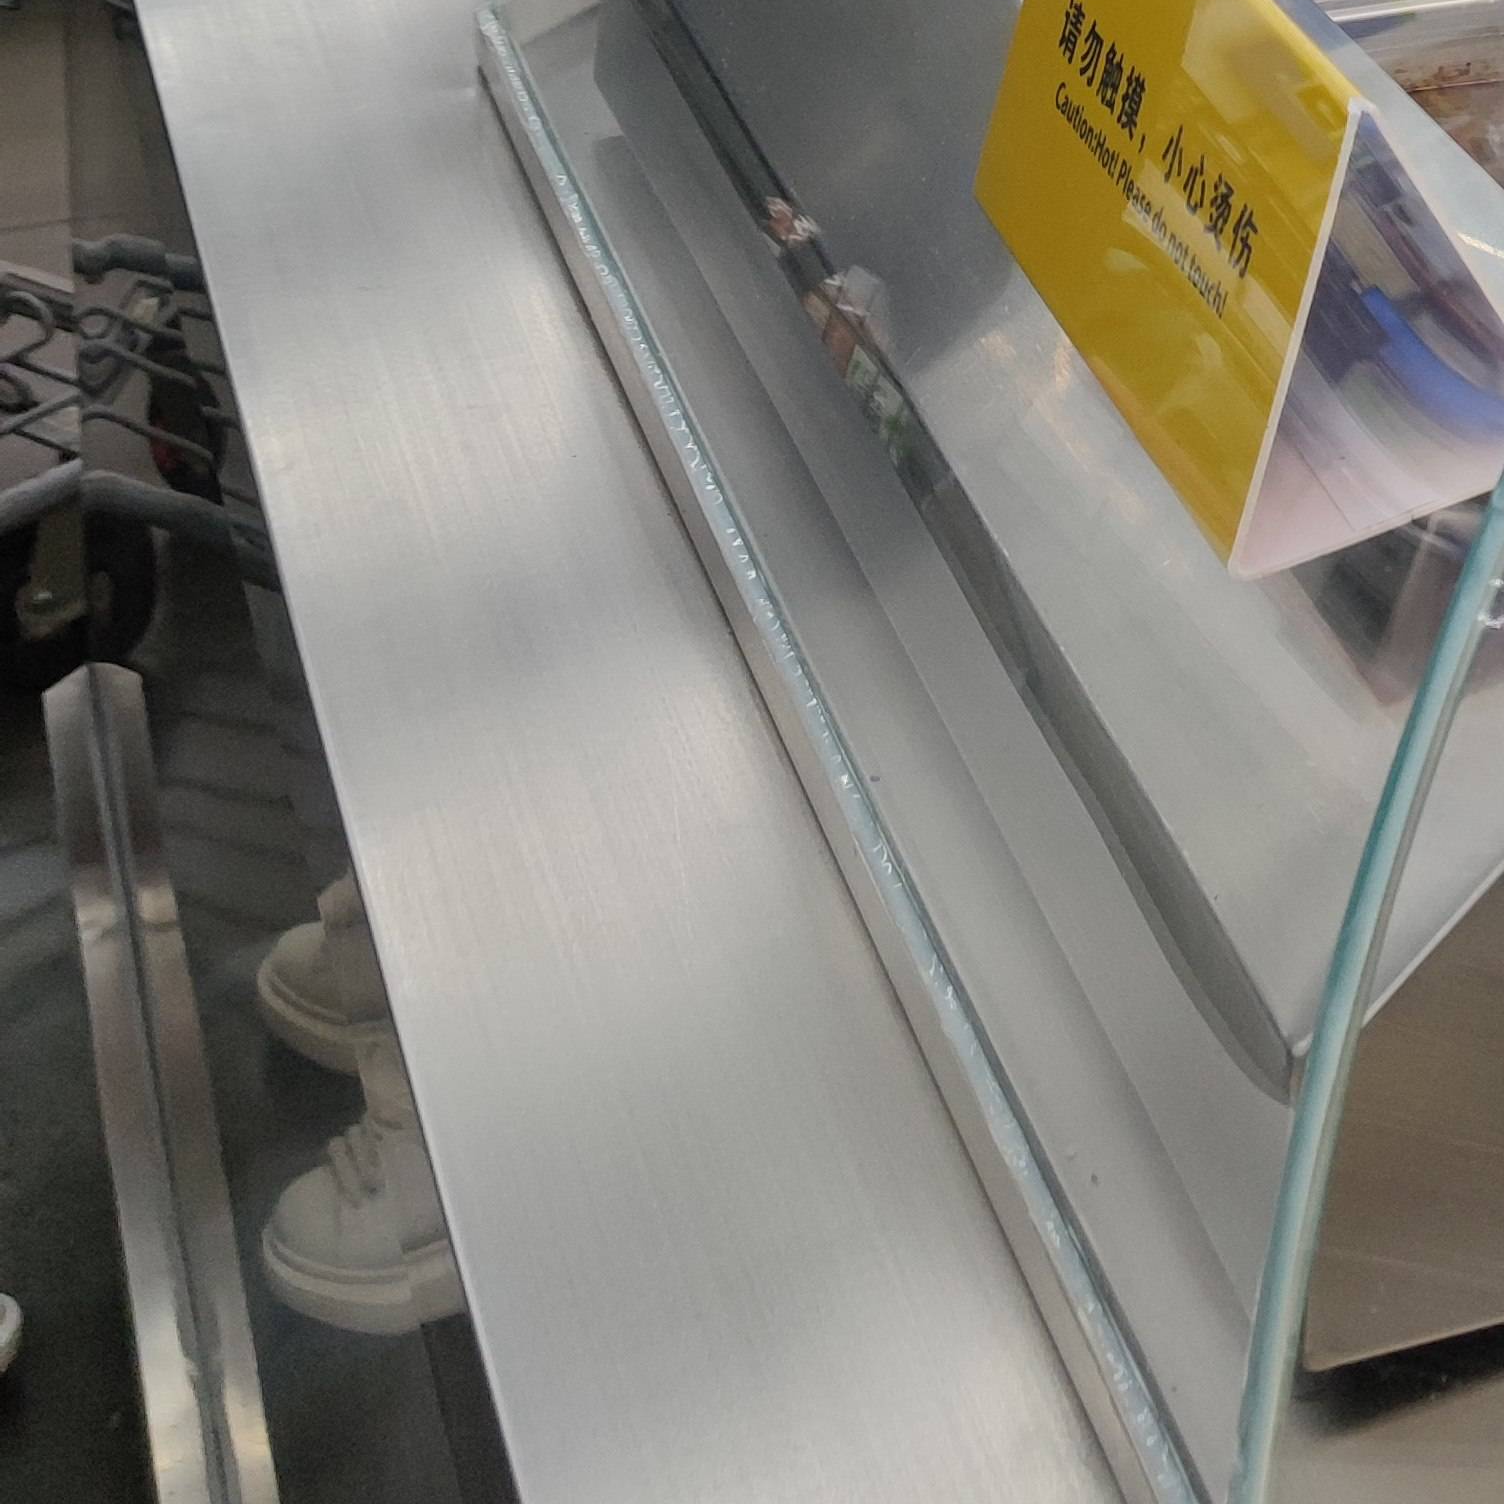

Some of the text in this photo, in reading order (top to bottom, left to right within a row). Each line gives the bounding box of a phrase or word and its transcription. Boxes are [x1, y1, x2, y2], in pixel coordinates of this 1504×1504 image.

[1054, 81, 1228, 320] Caution:Hot! Please do not touch!
